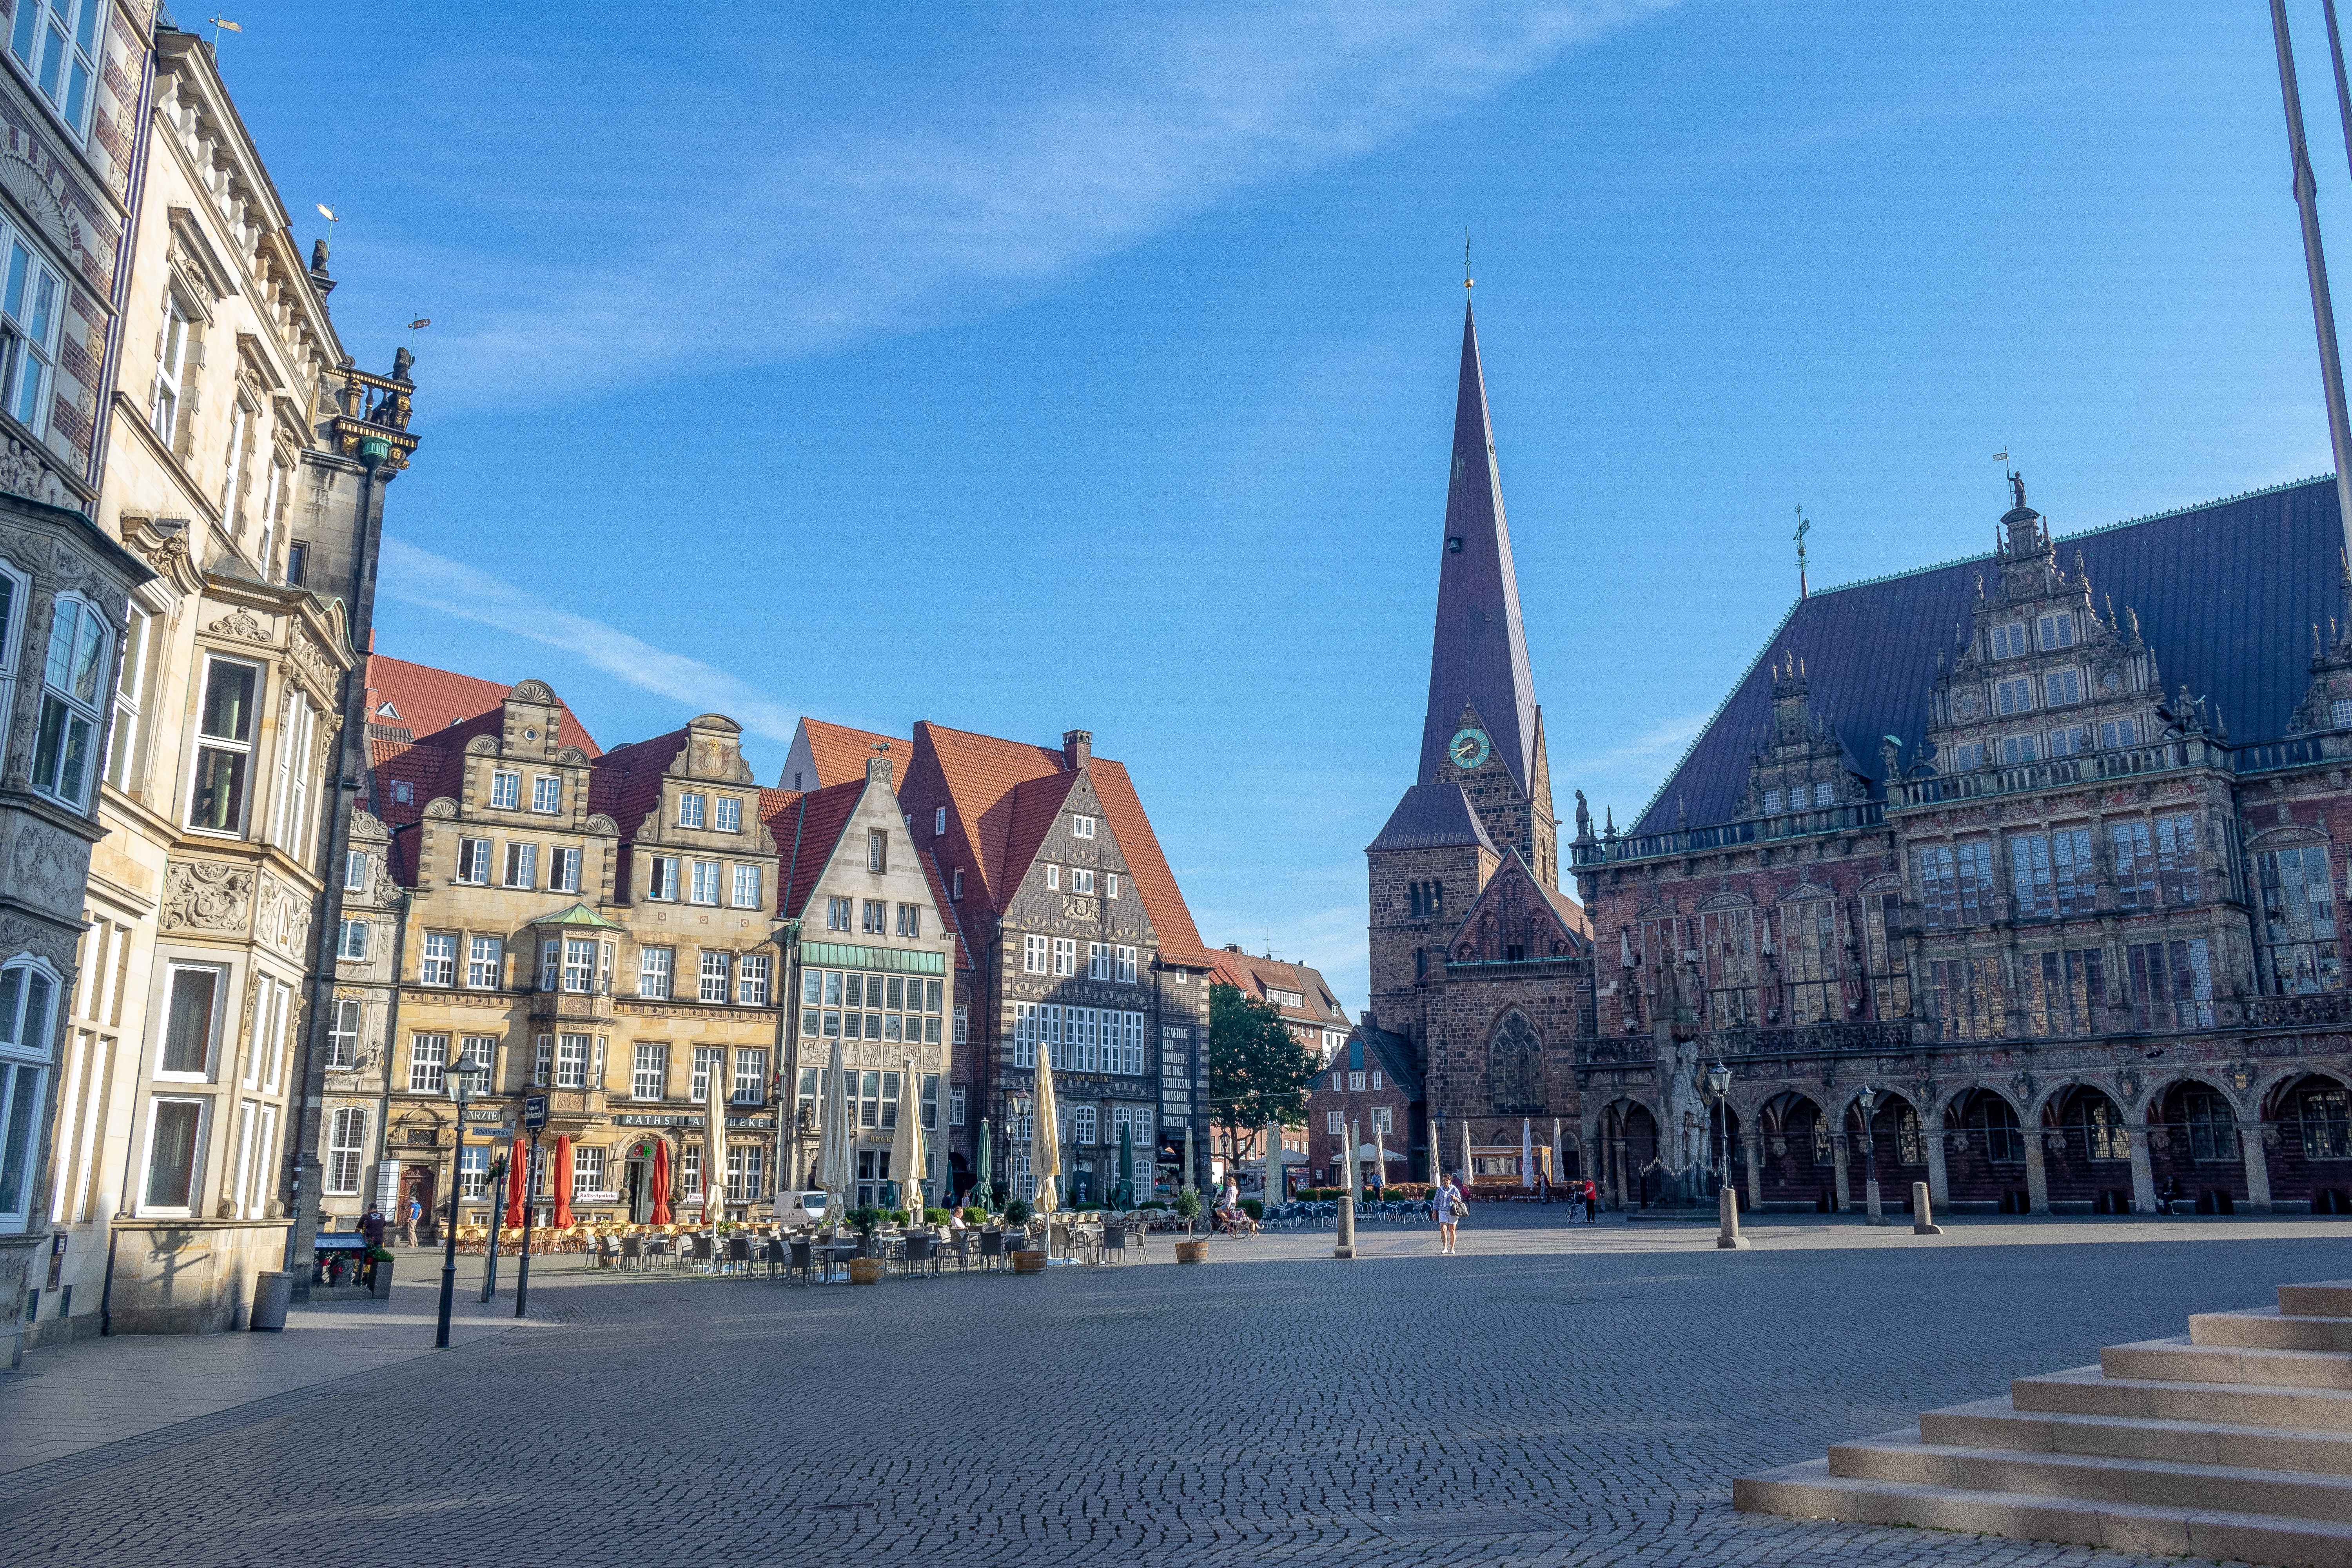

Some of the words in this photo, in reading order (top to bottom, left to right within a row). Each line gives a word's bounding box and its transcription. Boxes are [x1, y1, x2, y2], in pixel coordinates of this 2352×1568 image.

[1163, 1040, 1174, 1050] DER
[1163, 1051, 1188, 1065] BRÜDER,
[1163, 1065, 1172, 1075] DIE
[1173, 1065, 1183, 1076] DAS
[1162, 1078, 1191, 1089] SCHICKSAL
[1162, 1090, 1188, 1102] UNSERER
[1162, 1103, 1192, 1115] TRENNUNG
[626, 1115, 670, 1125] RATHS
[692, 1117, 764, 1127] AHEKE
